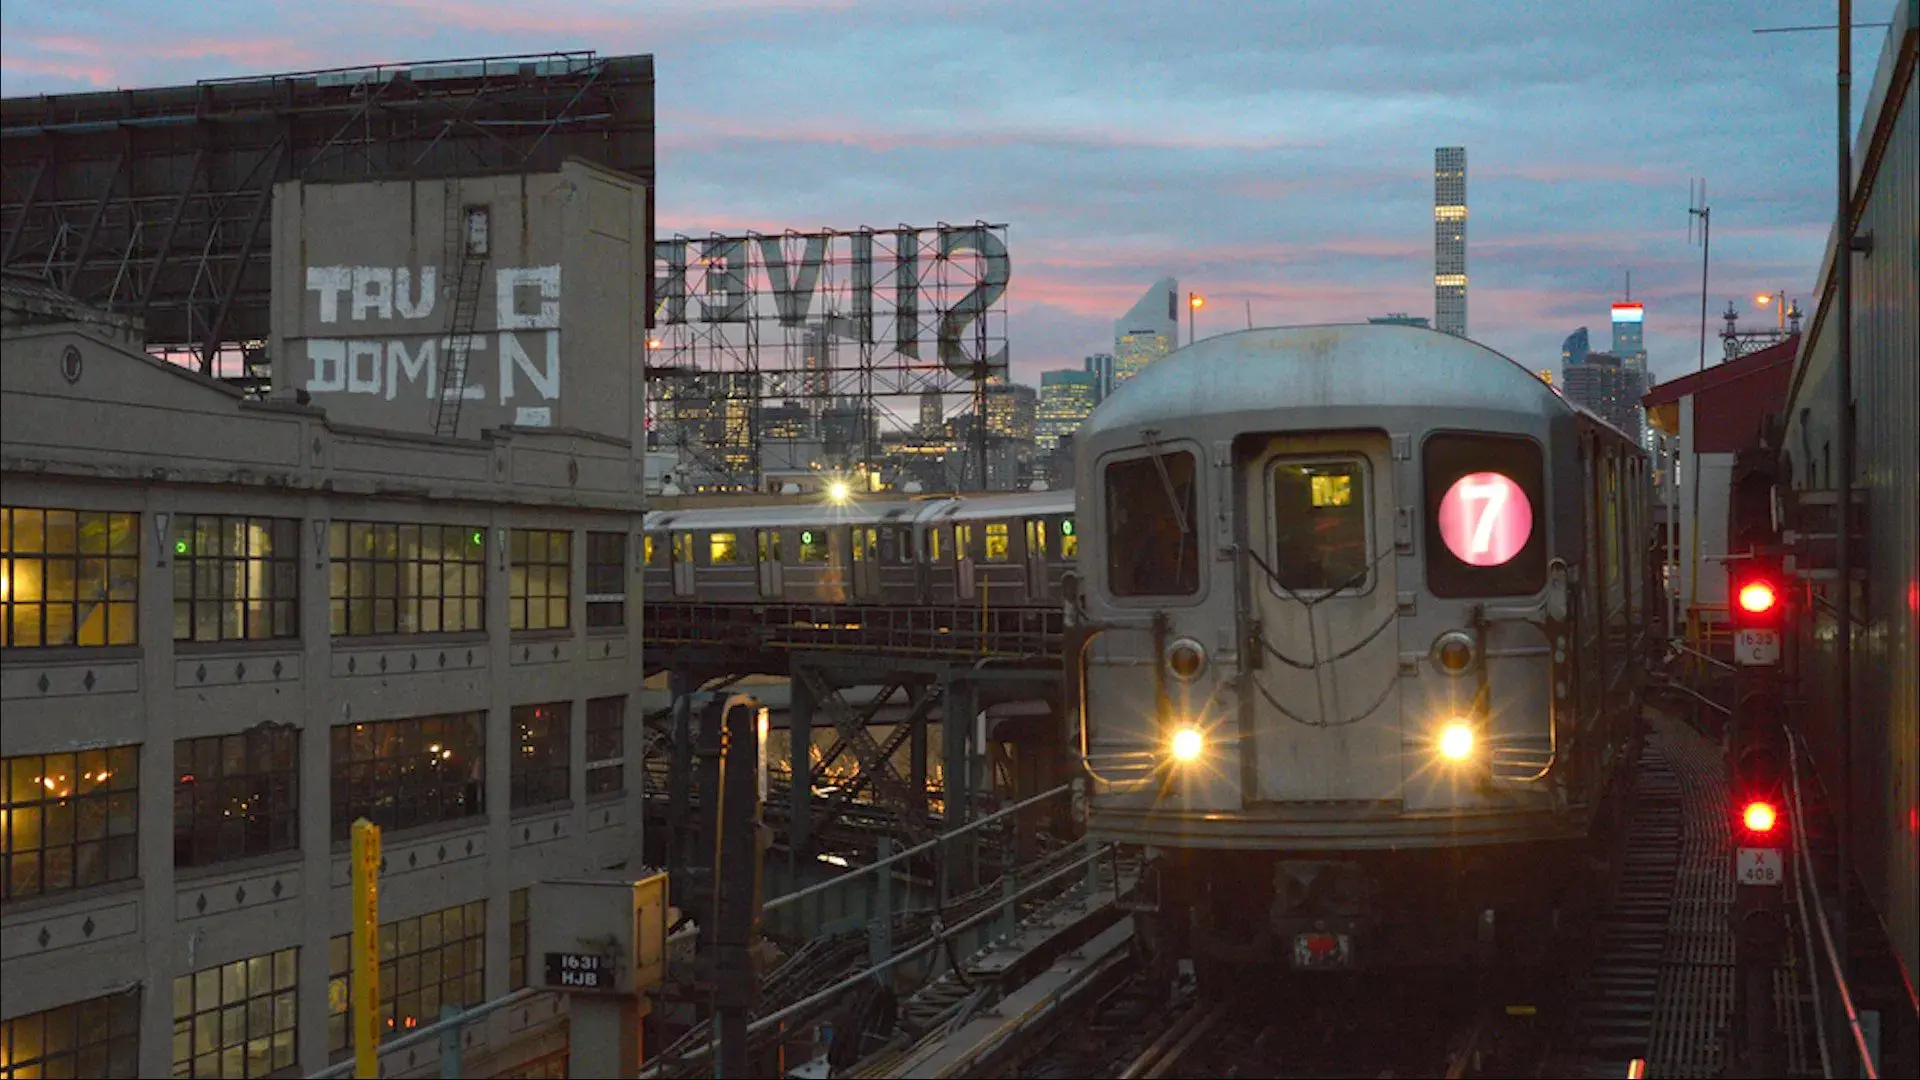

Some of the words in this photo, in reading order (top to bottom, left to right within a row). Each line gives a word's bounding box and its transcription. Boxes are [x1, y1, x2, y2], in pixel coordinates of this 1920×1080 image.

[1459, 483, 1509, 553] 7
[1755, 851, 1765, 865] X
[562, 954, 598, 970] 1631
[562, 971, 598, 986] HJB
